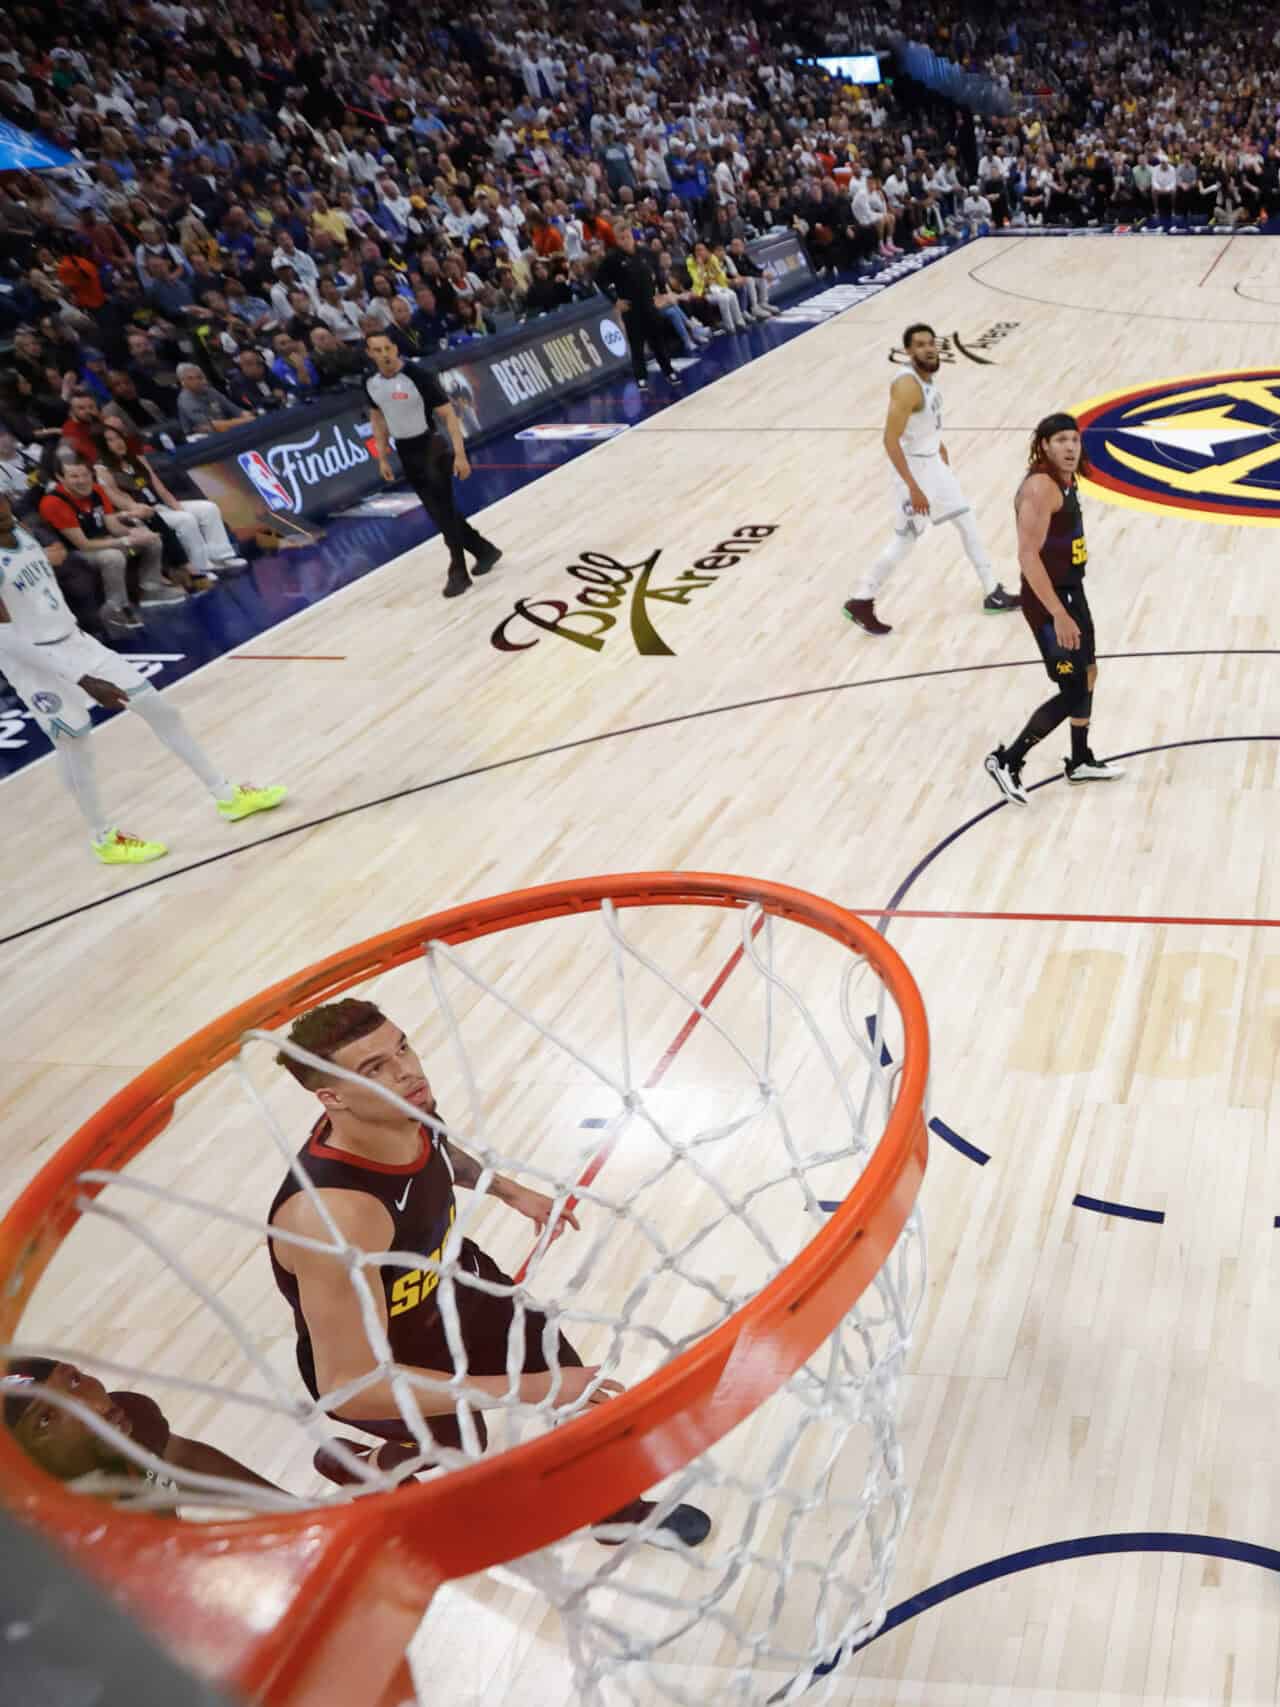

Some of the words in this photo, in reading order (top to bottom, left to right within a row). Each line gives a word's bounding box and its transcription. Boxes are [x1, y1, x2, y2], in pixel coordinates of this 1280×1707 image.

[489, 348, 552, 406] BEGIN
[542, 333, 592, 384] JUNE
[578, 327, 602, 368] 6
[267, 424, 369, 514] Finals
[12, 559, 53, 592] WOLVE
[490, 549, 677, 656] Ball
[645, 524, 780, 605] Arena
